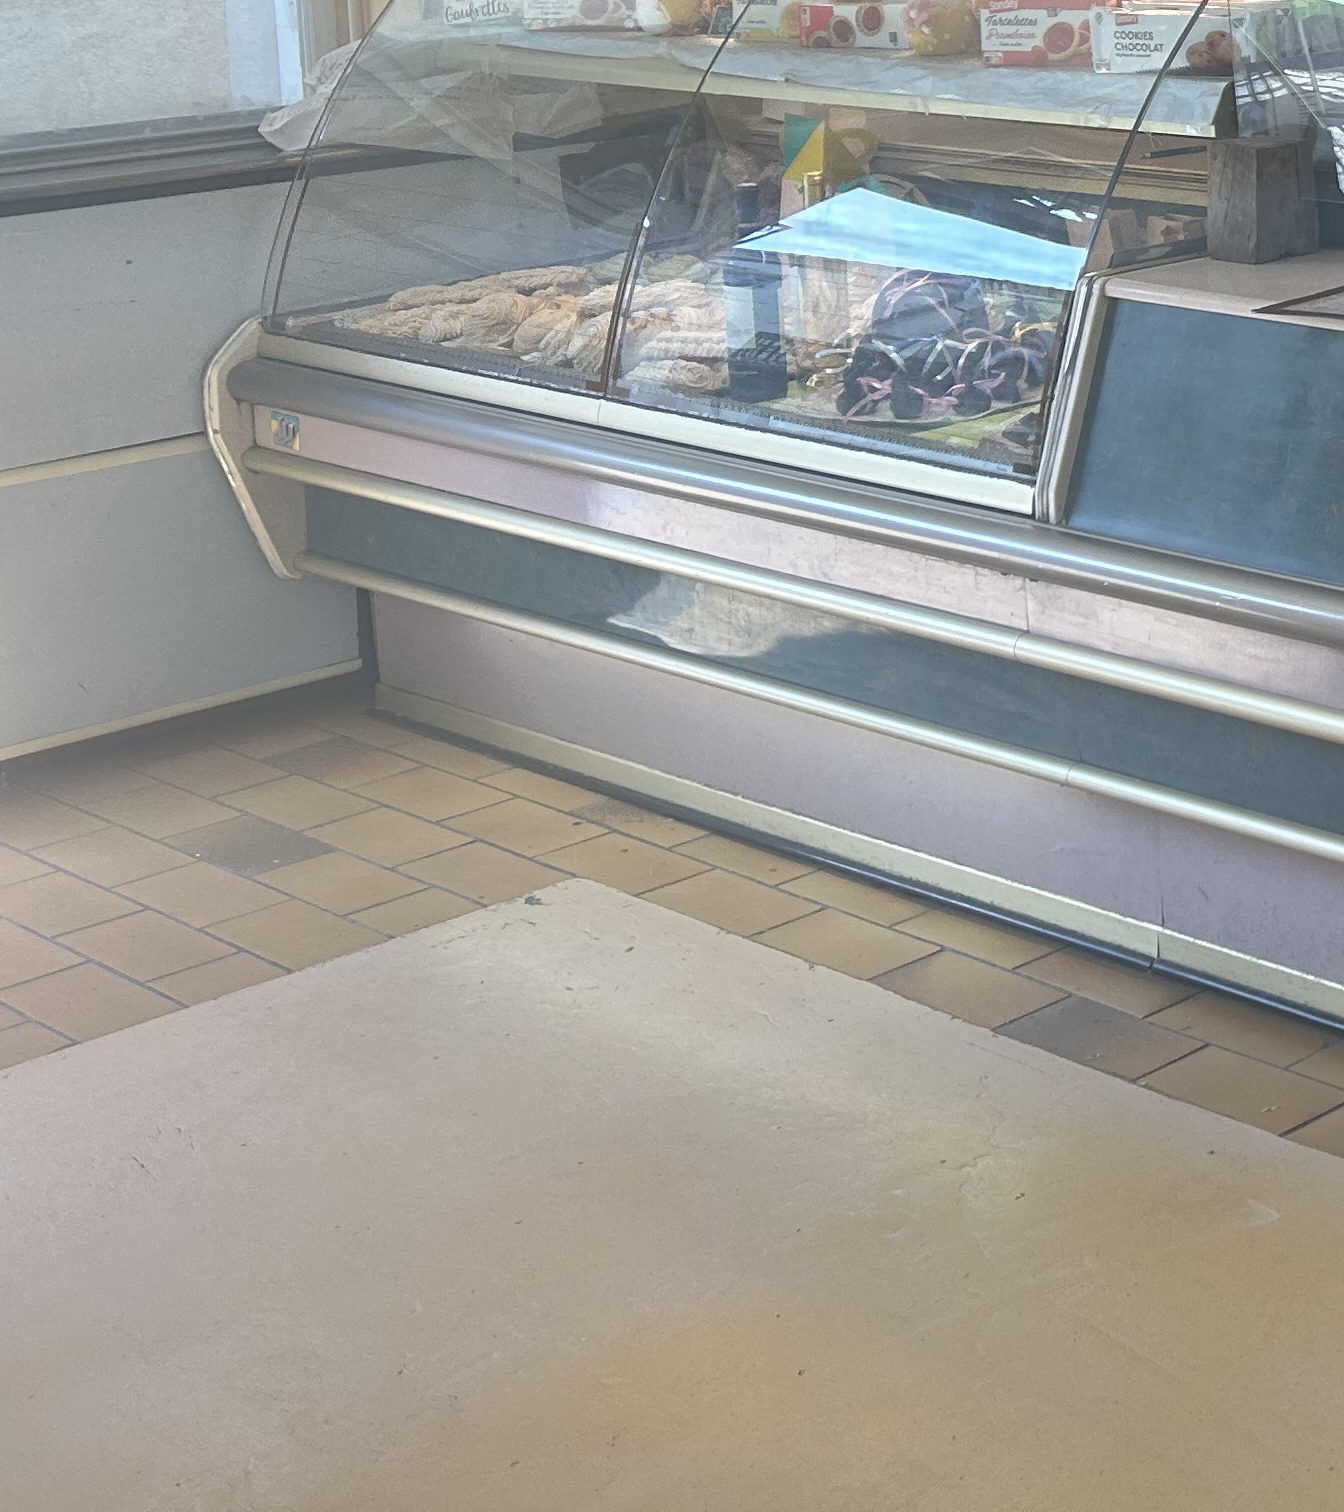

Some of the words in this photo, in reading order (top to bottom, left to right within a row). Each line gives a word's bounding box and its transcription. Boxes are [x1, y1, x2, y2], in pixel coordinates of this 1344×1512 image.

[988, 0, 1018, 11] Sondey
[445, 0, 510, 23] Gaufrettes
[1114, 30, 1154, 41] COOKIES
[1115, 42, 1165, 53] CHOCOLAT
